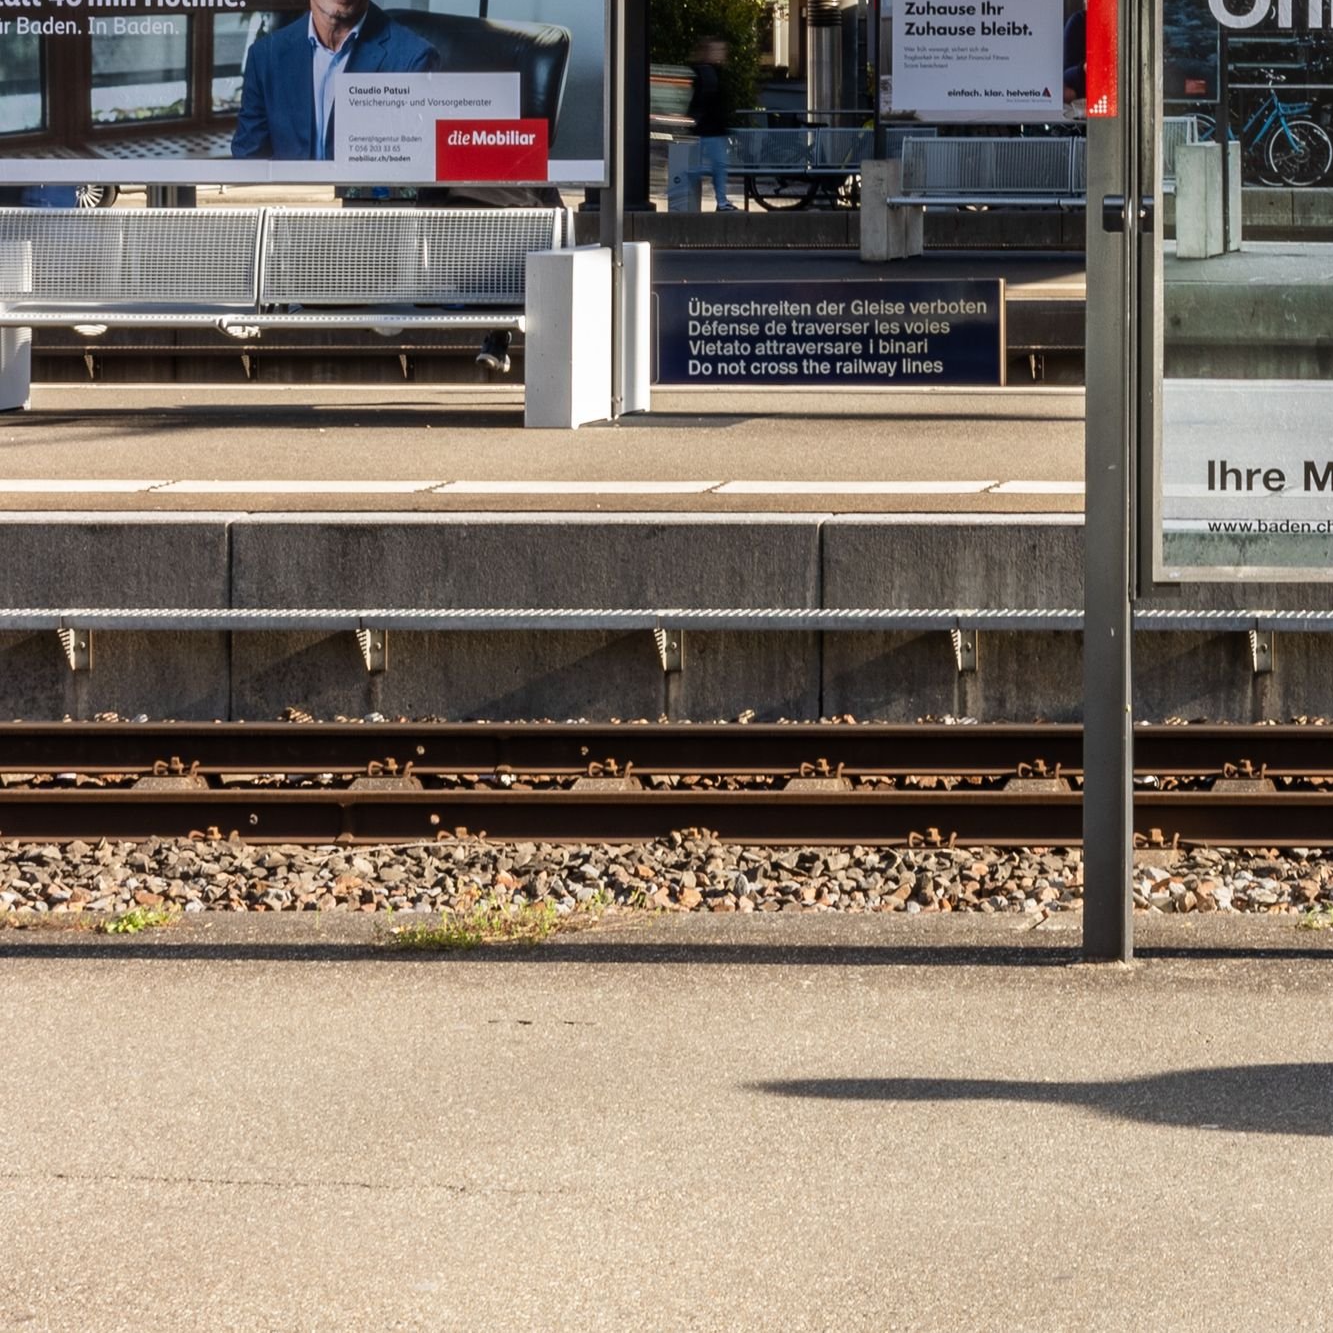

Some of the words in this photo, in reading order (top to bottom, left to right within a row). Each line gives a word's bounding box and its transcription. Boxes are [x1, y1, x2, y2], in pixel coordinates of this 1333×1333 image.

[904, 1, 976, 16] Zuhause
[981, 1, 1004, 16] Ihr
[16, 16, 82, 35] Baden.
[87, 16, 107, 35] In
[113, 16, 180, 35] Baden.
[904, 22, 976, 36] Zuhause
[981, 22, 1033, 36] bleibt.
[348, 86, 382, 95] Claudio
[384, 86, 410, 95] Patusi
[948, 89, 982, 97] einfach.
[984, 89, 1004, 97] klar.
[1006, 89, 1041, 97] helvetia
[348, 98, 408, 108] Versicherungs-
[410, 98, 426, 107] und
[427, 98, 492, 108] Vorsorgeberater
[400, 135, 422, 143] Baden
[447, 130, 471, 146] die
[472, 130, 536, 146] Mobiliar
[354, 145, 368, 153] 056
[348, 155, 411, 163] mobiliar.ch/baden
[688, 297, 811, 316] Überschreiten
[816, 300, 846, 316] der
[851, 299, 905, 315] Gleise
[909, 299, 988, 315] verboten
[688, 320, 760, 336] Défense
[764, 320, 787, 335] de
[792, 321, 869, 335] traverser
[874, 319, 900, 334] les
[904, 319, 950, 334] voies
[688, 340, 751, 356] Vietato
[755, 340, 863, 355] attraversare
[869, 339, 874, 354] i
[879, 338, 929, 354] binari
[688, 359, 712, 375] Do
[717, 360, 746, 375] not
[751, 361, 798, 375] cross
[802, 359, 831, 374] the
[836, 359, 897, 377] railway
[902, 357, 944, 374] lines
[1206, 459, 1286, 492] Ihre
